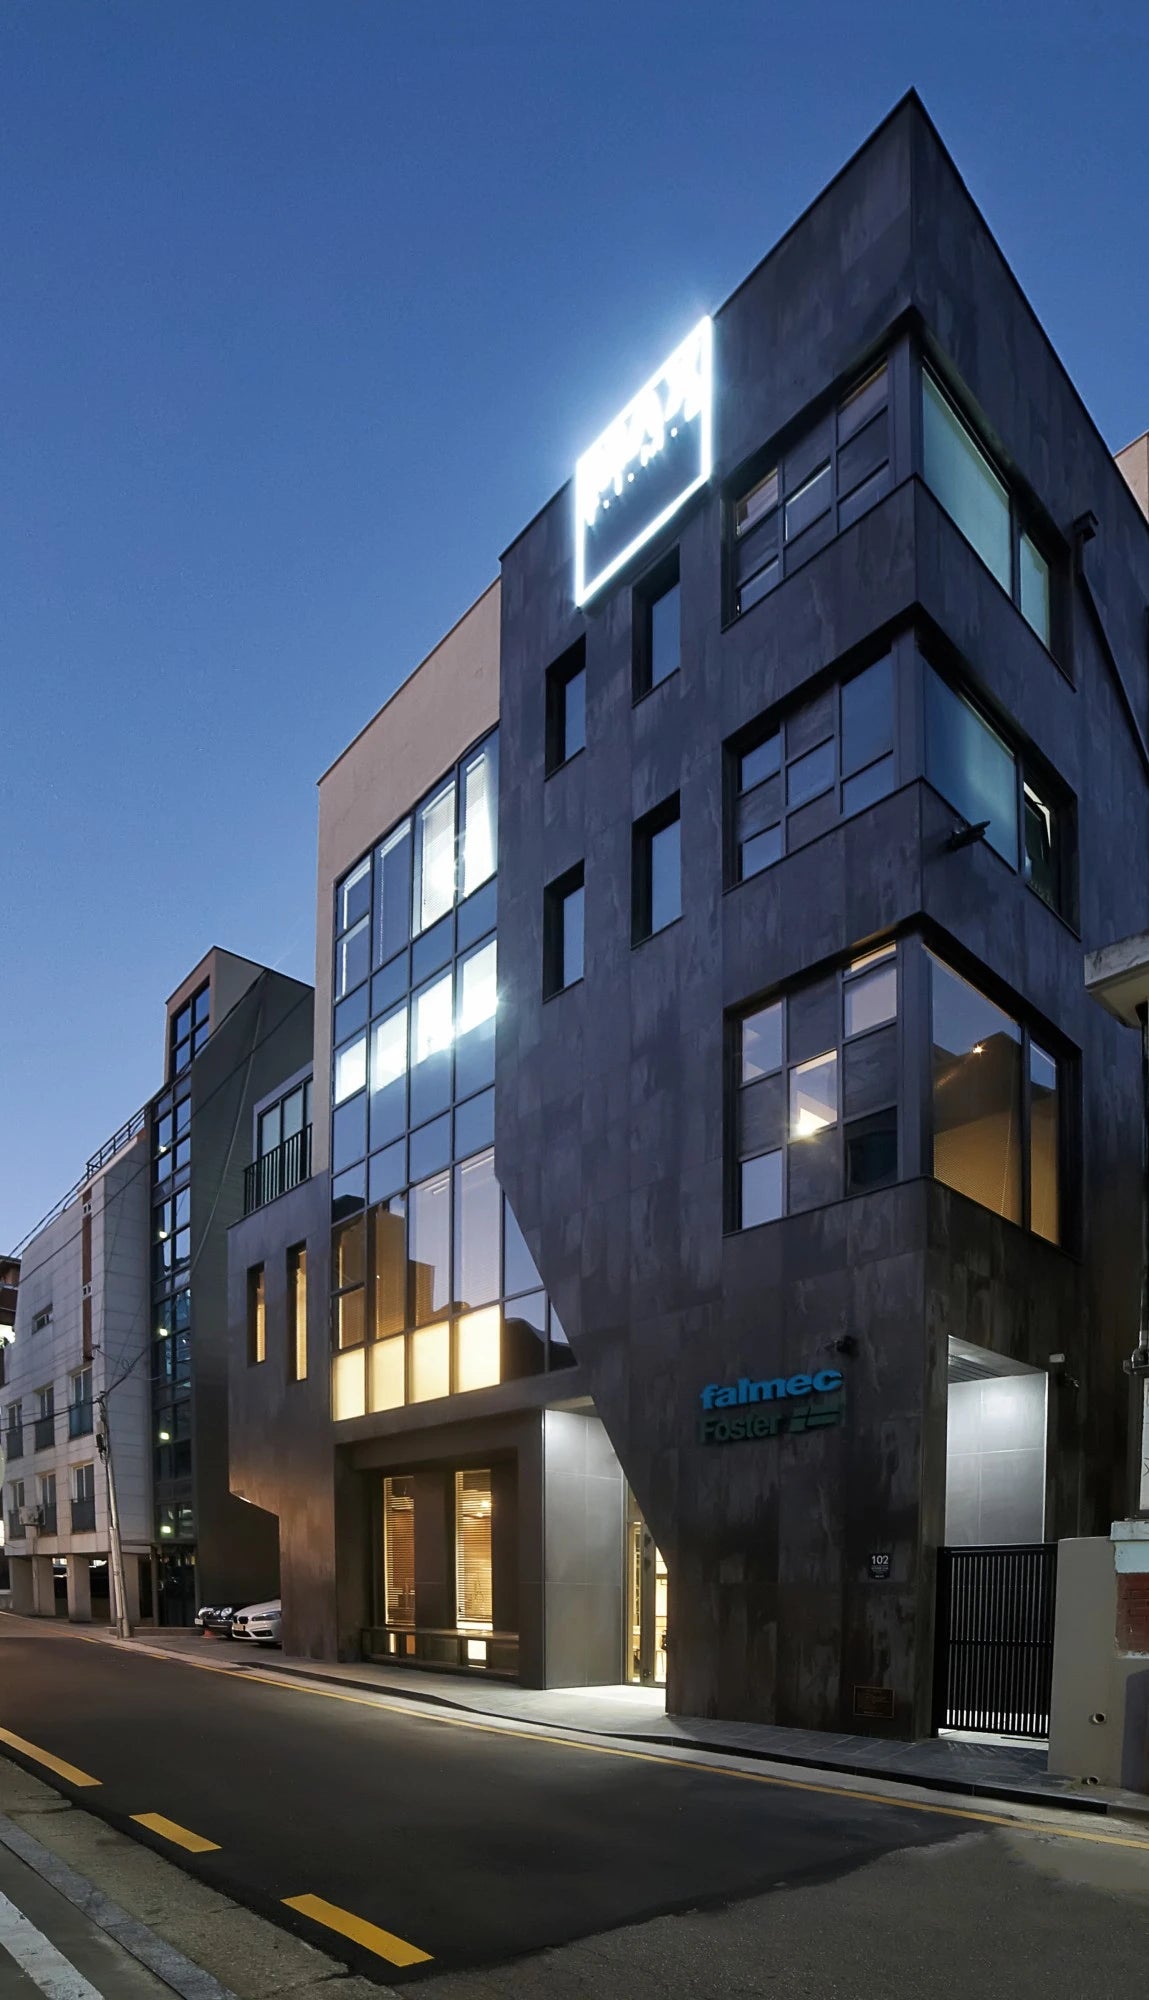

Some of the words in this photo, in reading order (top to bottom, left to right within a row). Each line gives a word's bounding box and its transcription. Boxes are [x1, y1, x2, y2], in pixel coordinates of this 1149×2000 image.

[701, 1369, 842, 1409] falmec
[701, 1411, 782, 1441] Foster
[871, 1555, 889, 1565] 102
